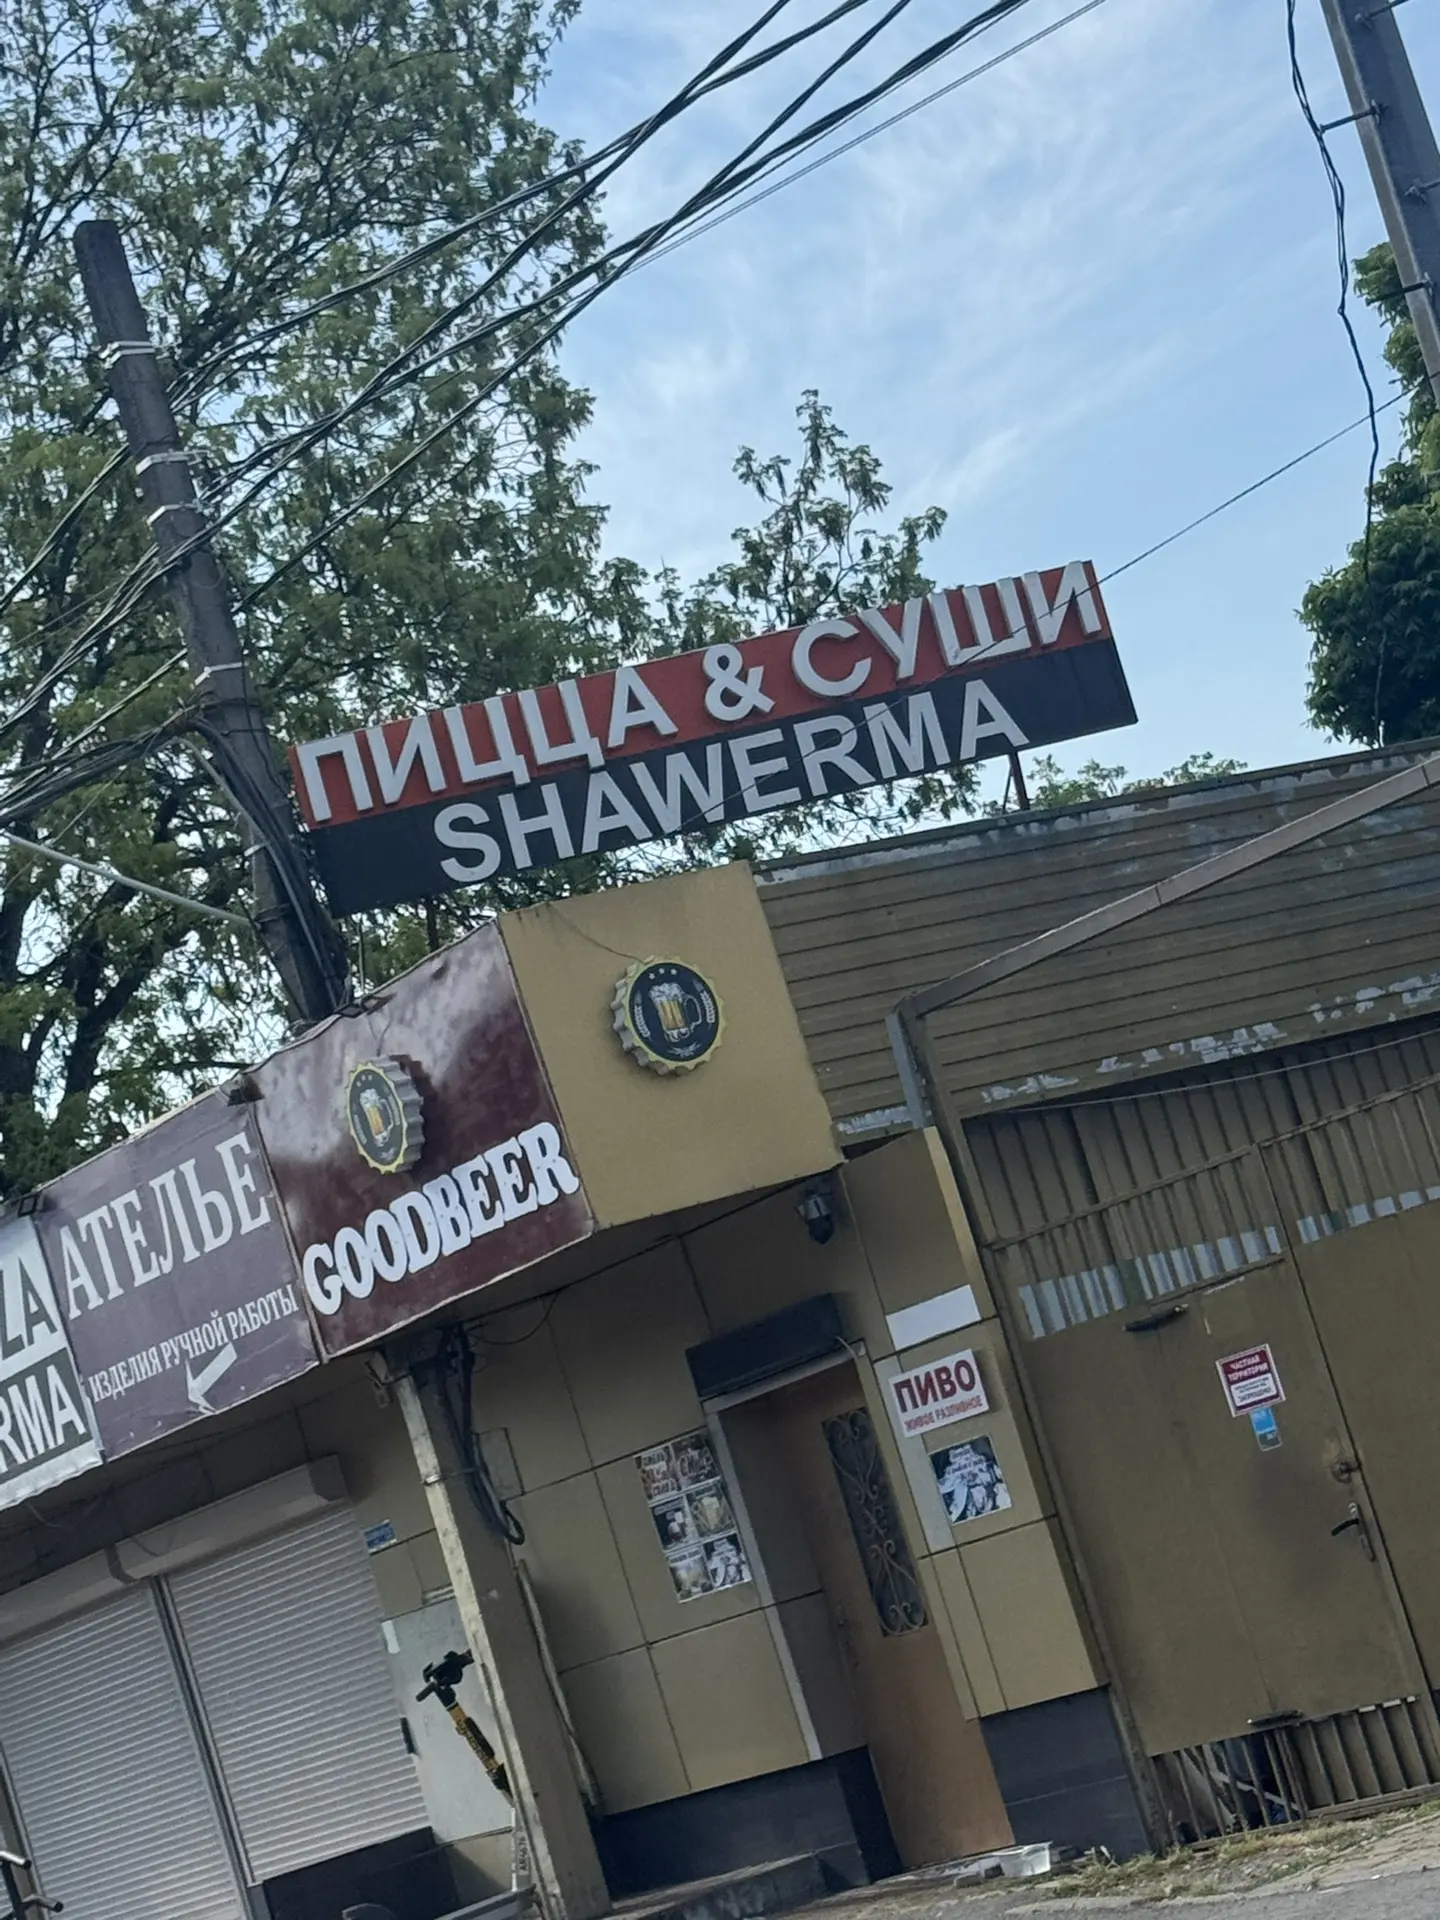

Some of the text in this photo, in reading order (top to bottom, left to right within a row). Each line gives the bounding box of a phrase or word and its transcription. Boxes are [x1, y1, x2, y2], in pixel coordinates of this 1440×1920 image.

[298, 561, 1103, 822] ПИЦЦА & СУШИ
[433, 679, 1031, 884] SHAWERMA
[58, 1131, 272, 1321] АТЕЛЬЕ
[88, 1284, 300, 1403] ИЗДЕЛИЯ РУЧНОЙ РАБОТЫ
[893, 1359, 976, 1413] ПИВО
